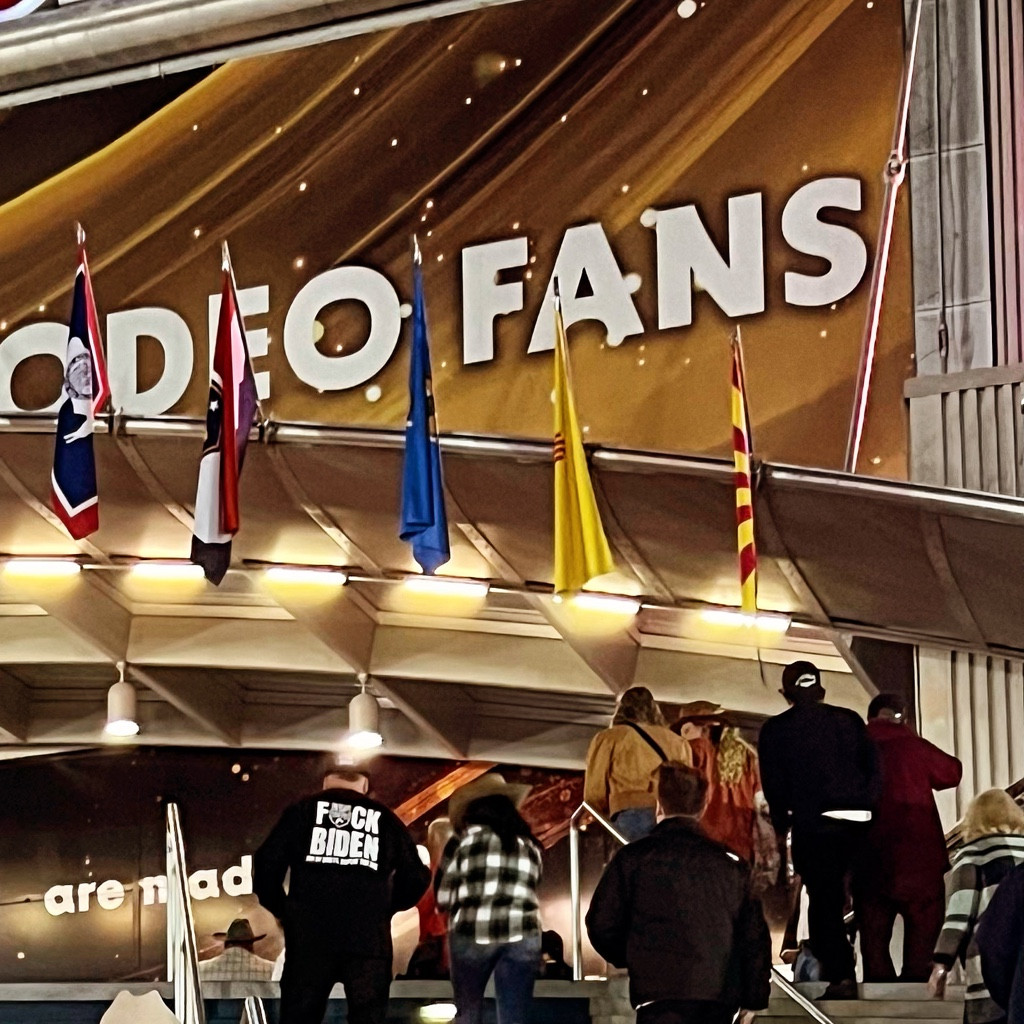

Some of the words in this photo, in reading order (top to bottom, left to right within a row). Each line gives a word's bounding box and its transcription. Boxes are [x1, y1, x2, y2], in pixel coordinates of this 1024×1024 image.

[461, 177, 868, 365] FANS
[315, 800, 381, 835] FCK
[309, 826, 379, 862] BIDEN
[43, 879, 125, 917] are
